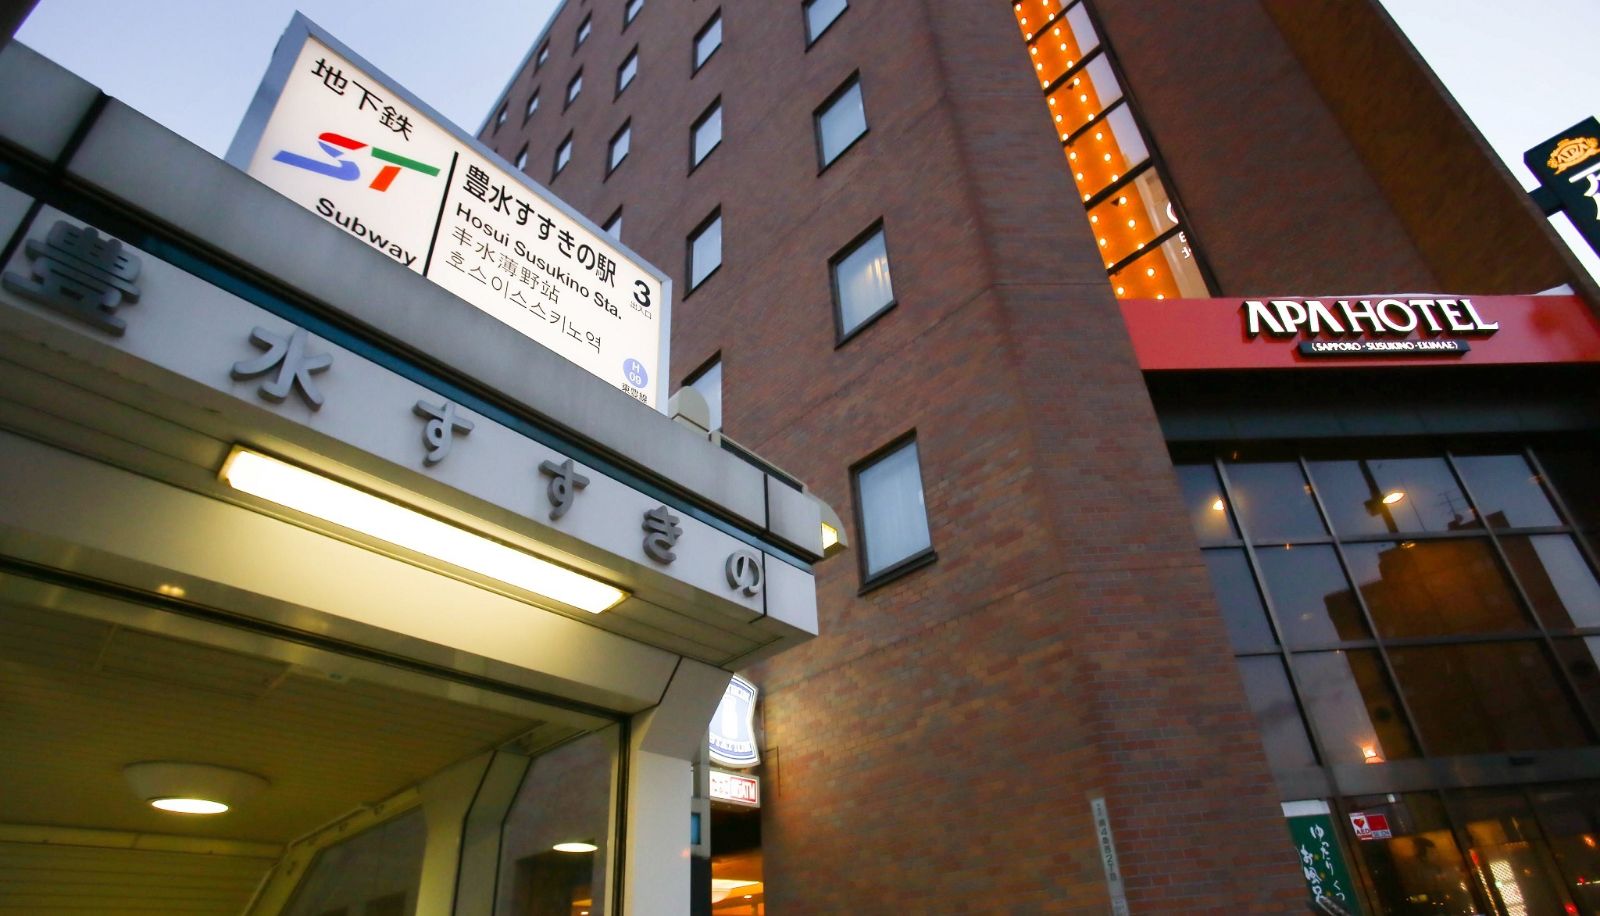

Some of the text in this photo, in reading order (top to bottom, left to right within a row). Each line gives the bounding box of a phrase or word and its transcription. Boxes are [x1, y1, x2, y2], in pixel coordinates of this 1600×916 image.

[311, 58, 414, 141] 地下鉄
[316, 197, 417, 267] Subway
[463, 165, 617, 288] 豊水すすきの駅
[456, 202, 622, 320] Hosui Susukino Sta.
[630, 300, 652, 320] 出入口
[633, 279, 651, 308] 3
[1245, 299, 1499, 334] APA HOTEL
[631, 361, 640, 373] H
